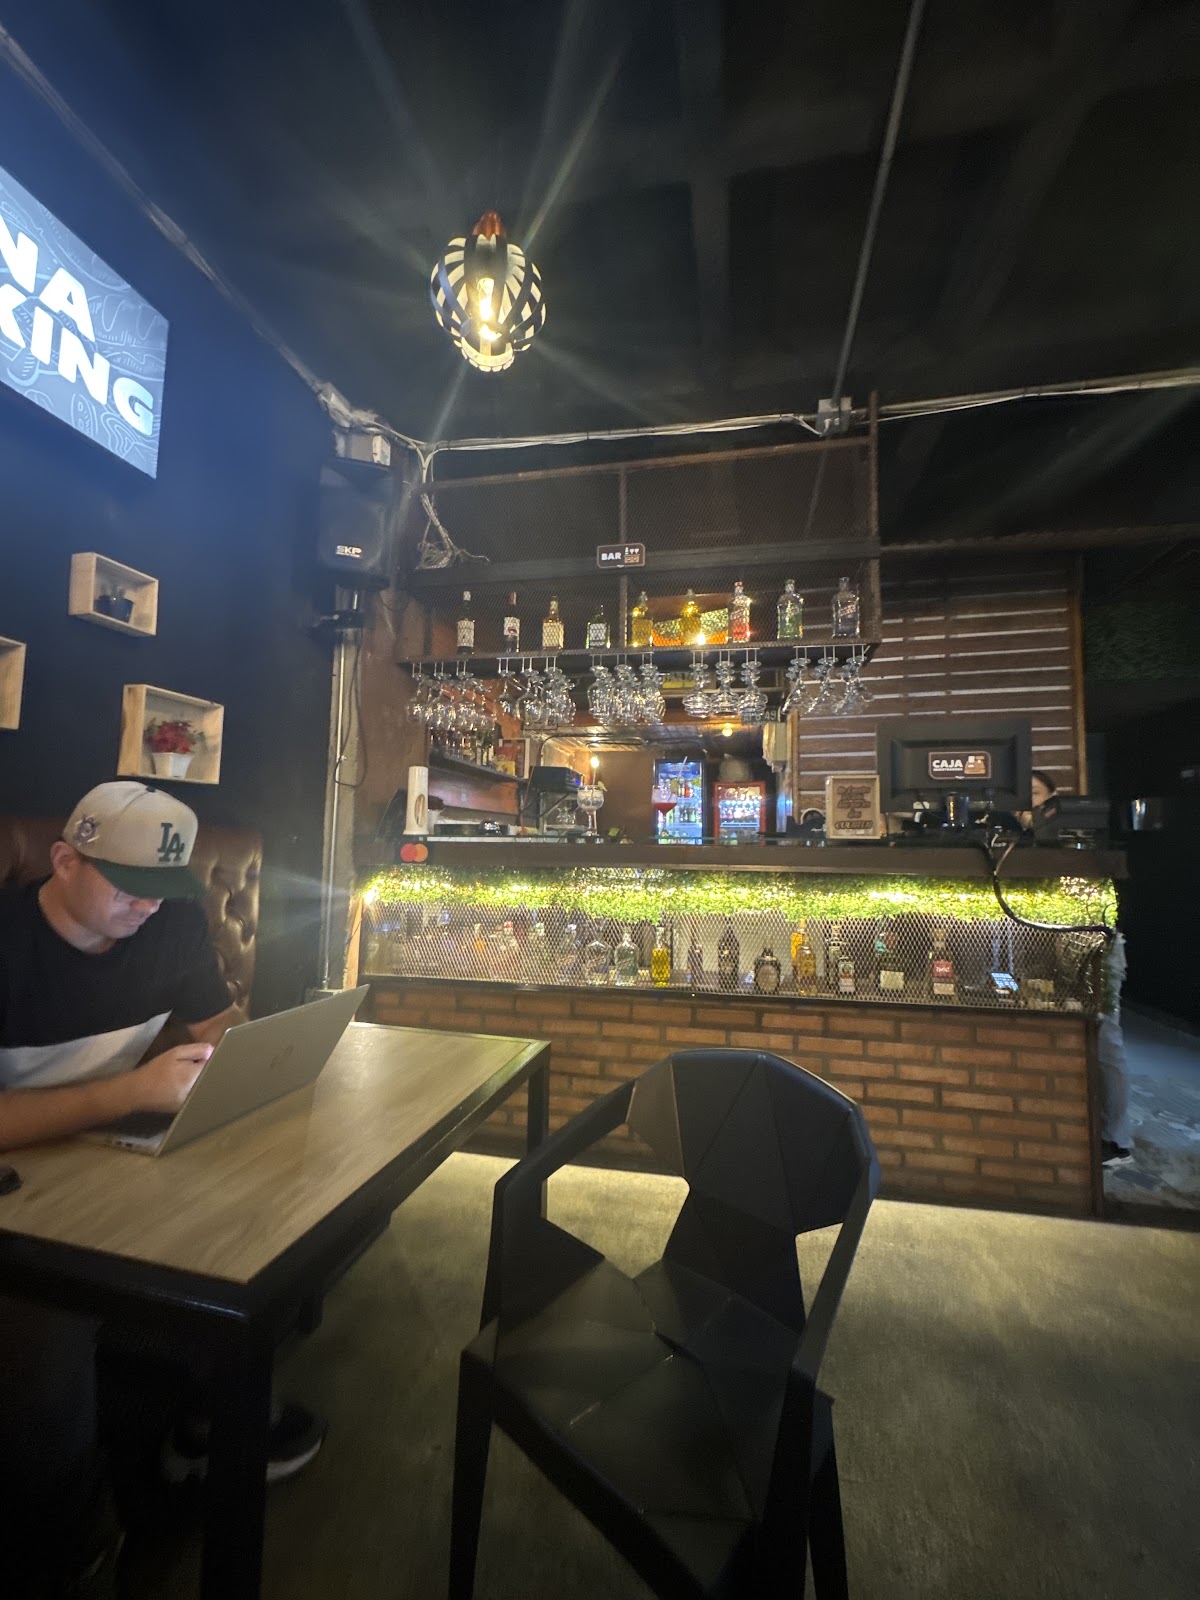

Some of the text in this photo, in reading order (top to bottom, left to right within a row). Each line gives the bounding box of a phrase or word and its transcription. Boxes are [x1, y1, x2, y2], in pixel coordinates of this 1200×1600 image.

[601, 552, 622, 561] BAR
[932, 759, 963, 768] CAJA
[157, 822, 185, 862] LA
